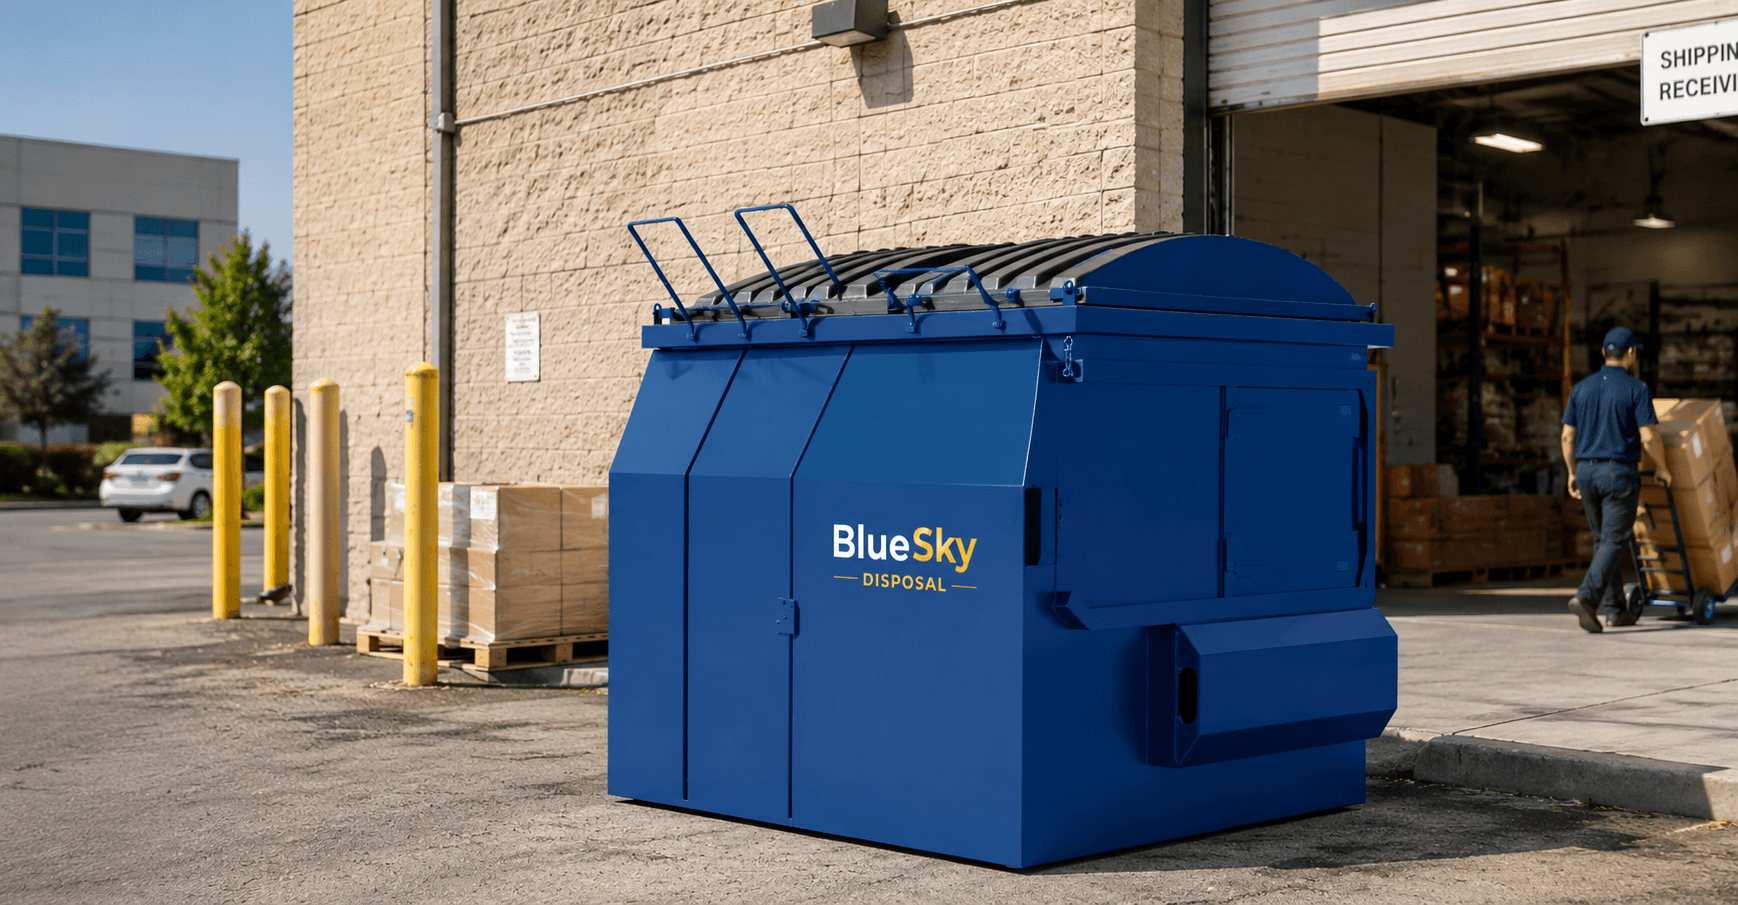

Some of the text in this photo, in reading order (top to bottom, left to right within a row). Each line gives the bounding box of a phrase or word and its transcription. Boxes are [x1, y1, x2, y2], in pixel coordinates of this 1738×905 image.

[1661, 41, 1738, 69] SHIPPIN
[1660, 73, 1737, 101] RECEIVI
[833, 523, 978, 573] BlueSky
[863, 572, 947, 592] DISPOSAL
